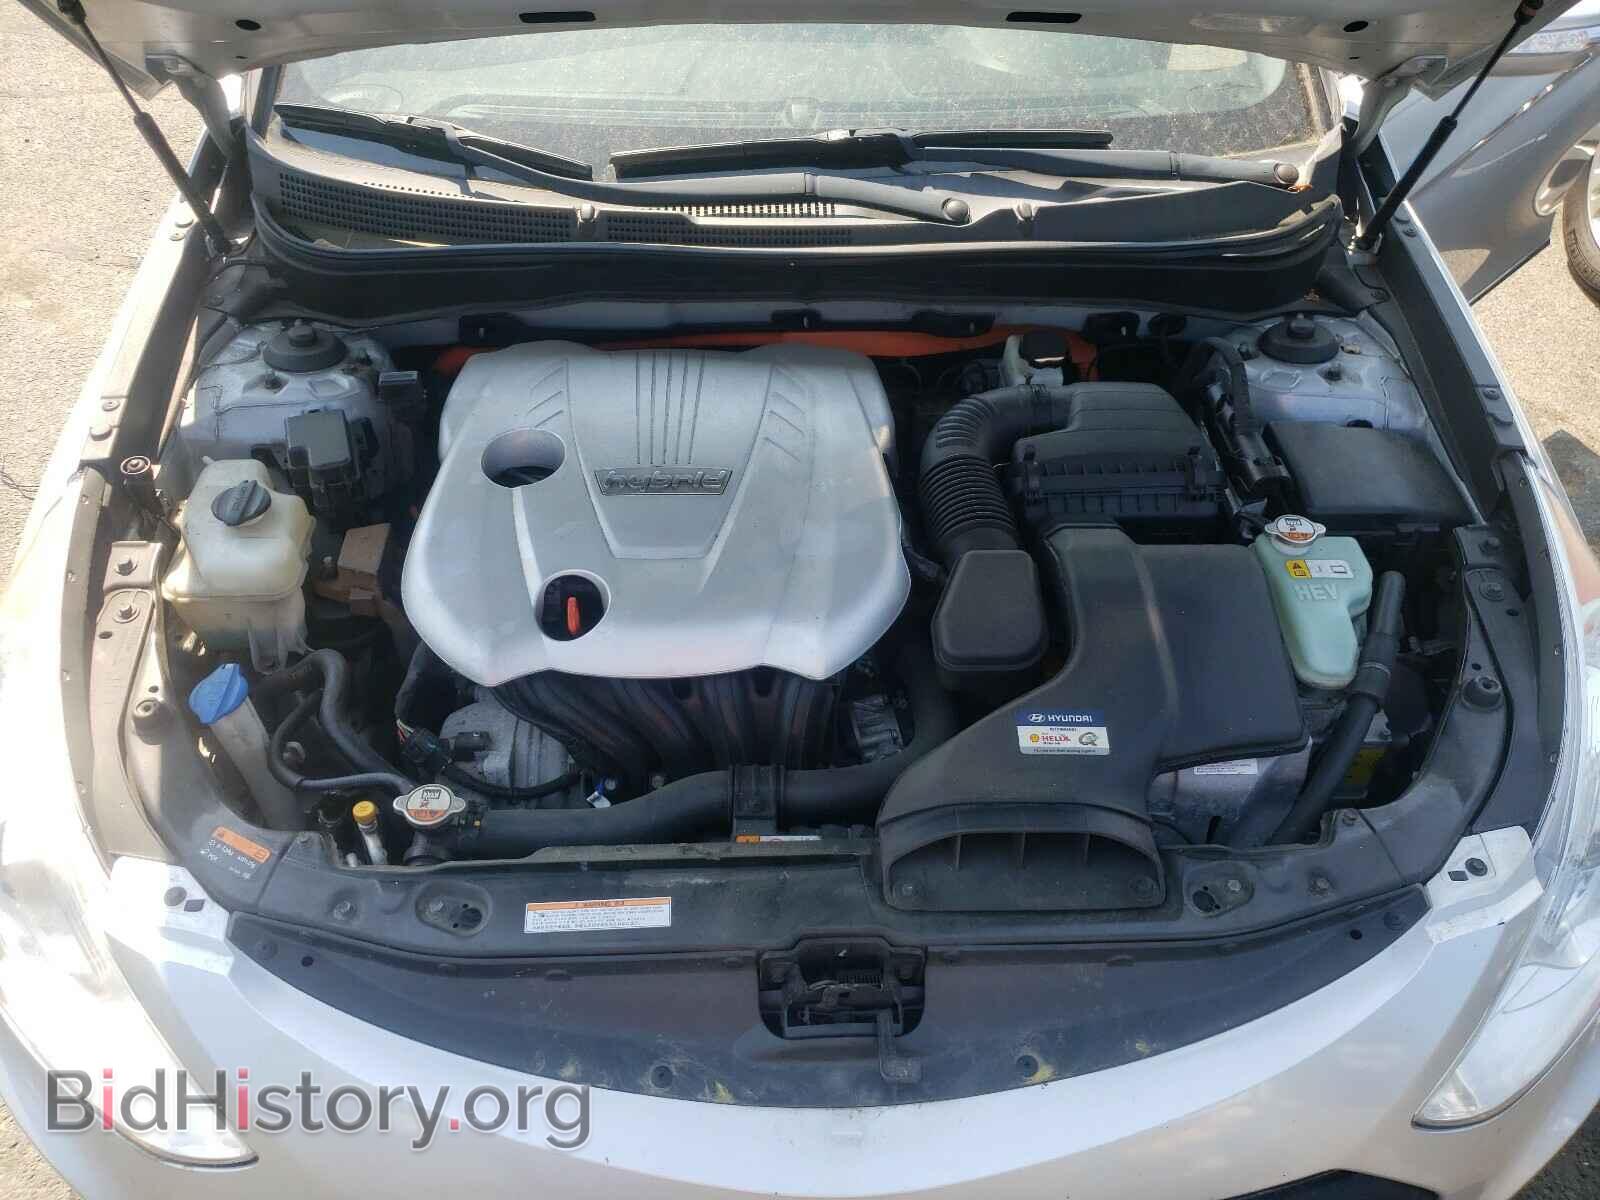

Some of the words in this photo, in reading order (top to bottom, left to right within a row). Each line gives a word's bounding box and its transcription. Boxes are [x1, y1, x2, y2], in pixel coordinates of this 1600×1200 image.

[605, 470, 728, 493] hybrid
[1295, 583, 1337, 601] HEV
[1047, 714, 1093, 723] HYUNDAI
